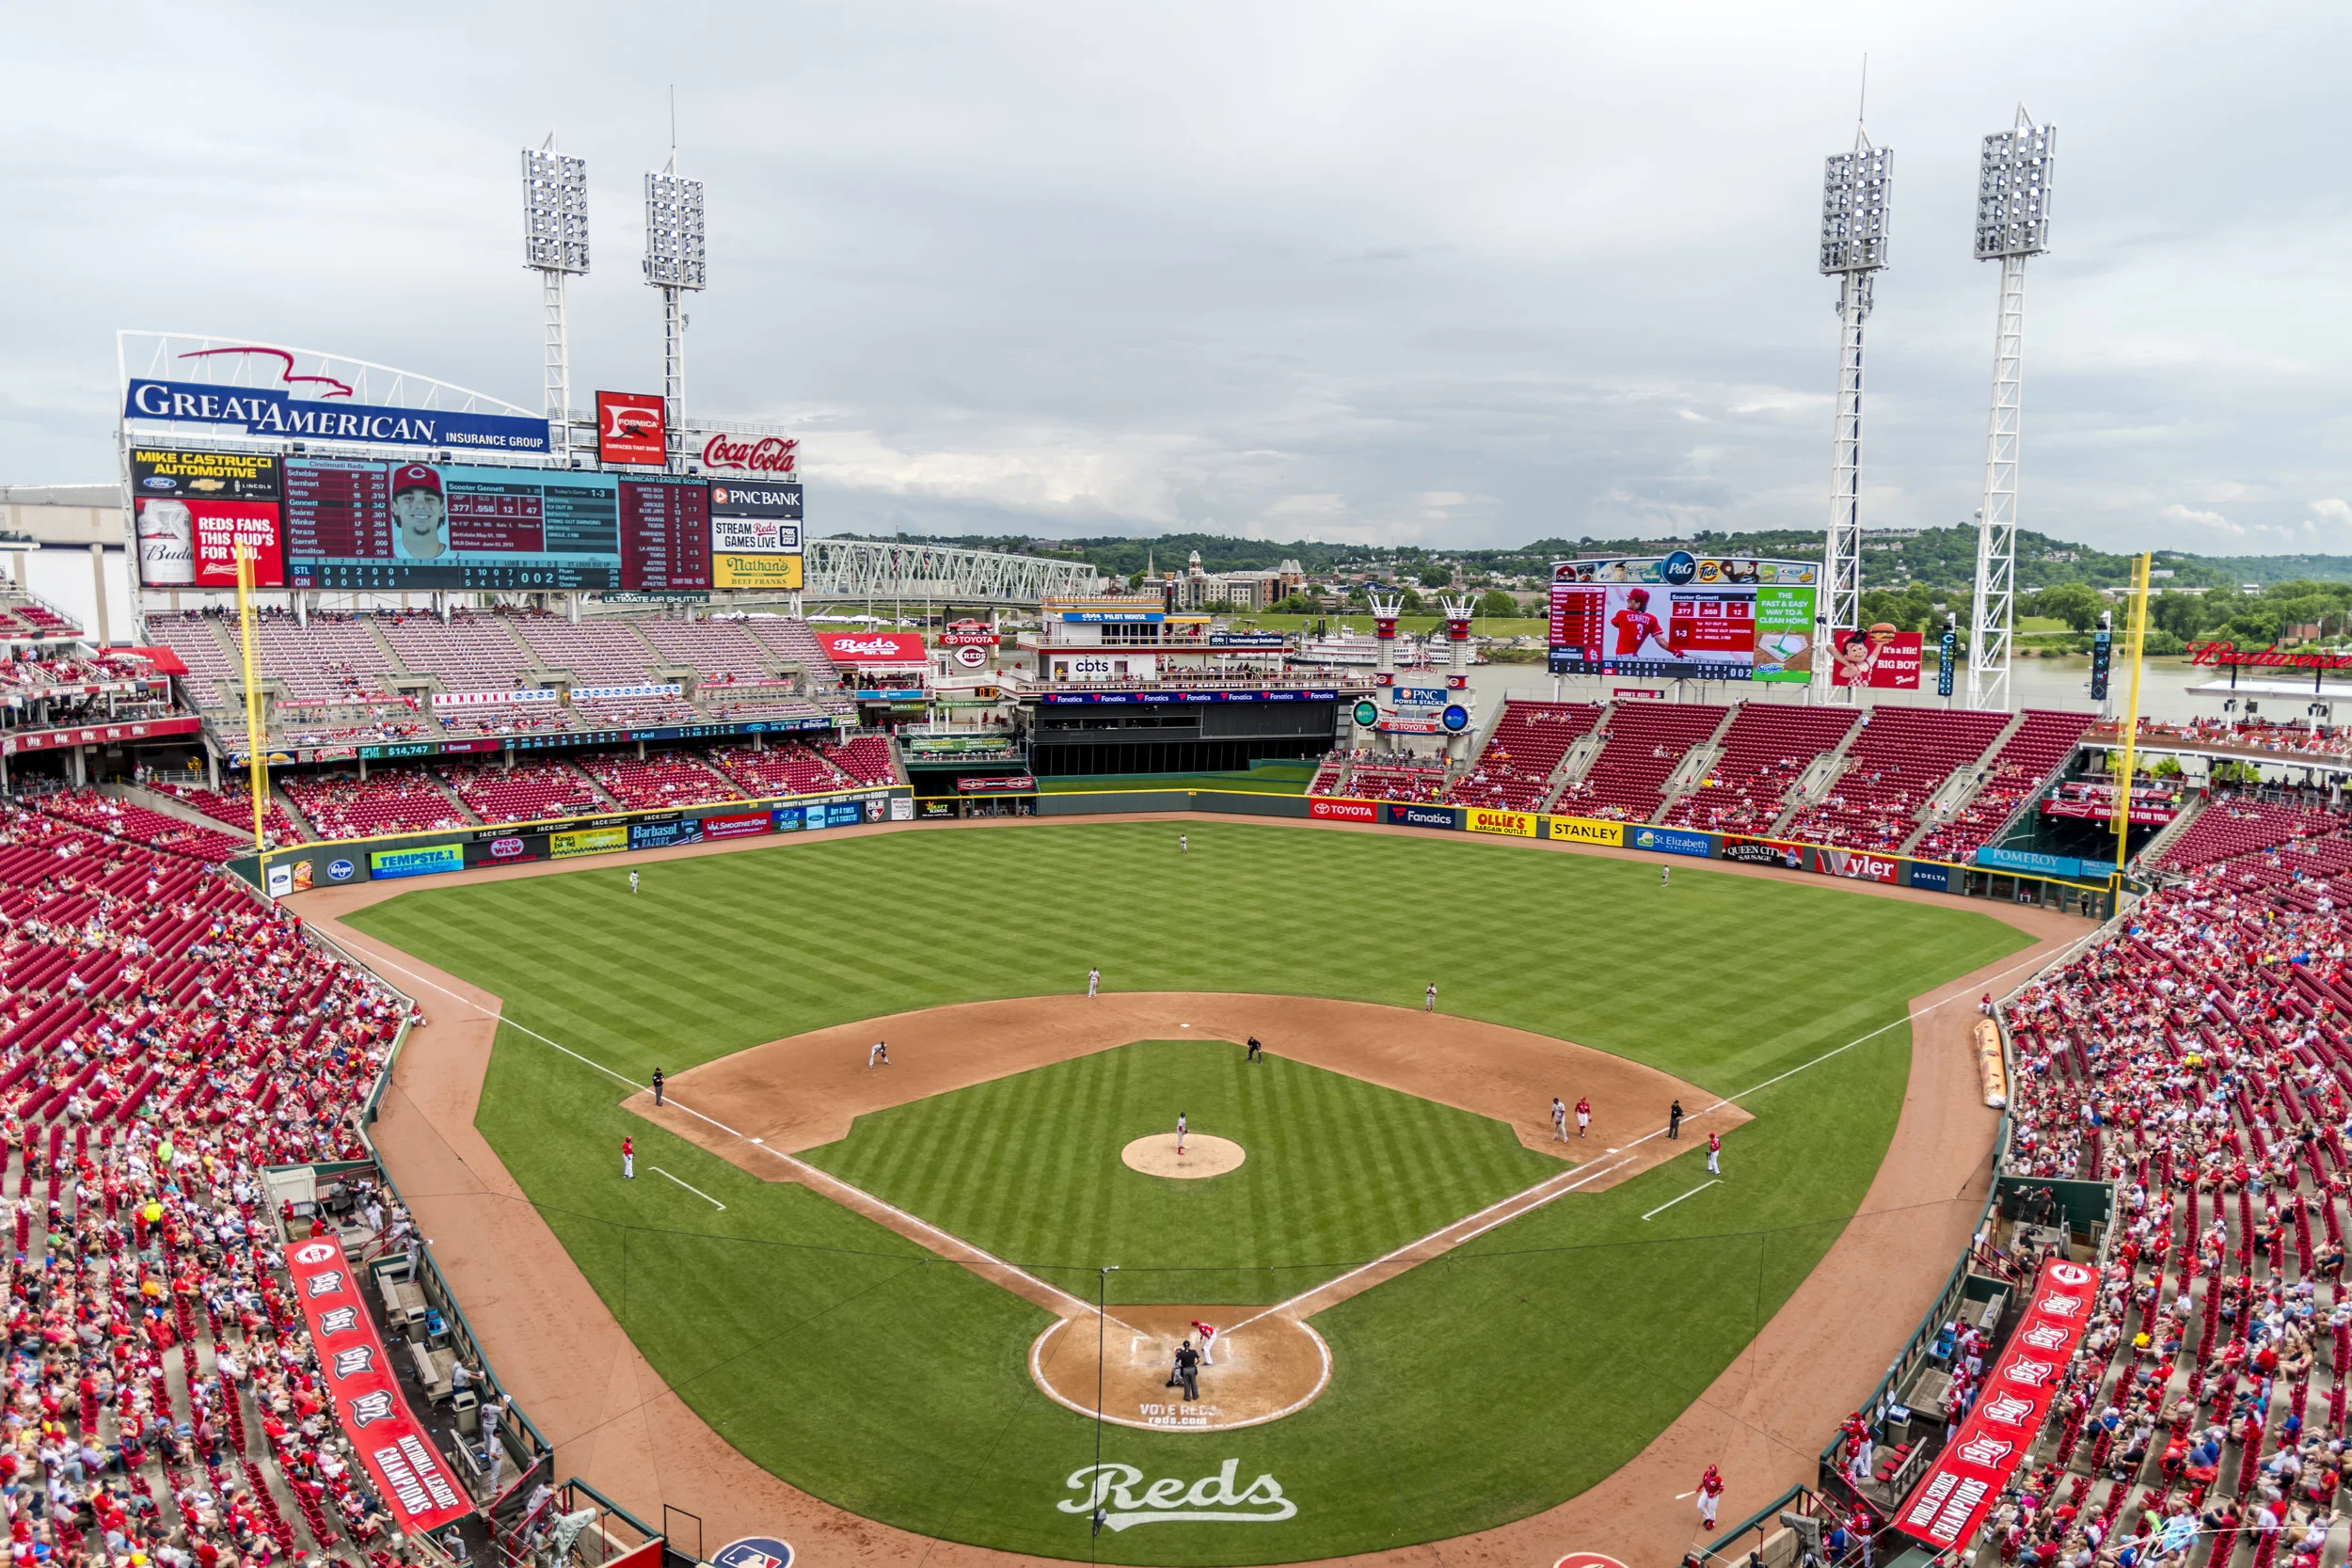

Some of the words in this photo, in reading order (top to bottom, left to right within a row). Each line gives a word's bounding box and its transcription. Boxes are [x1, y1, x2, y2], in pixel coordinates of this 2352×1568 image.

[135, 384, 274, 421] GREAT
[618, 419, 659, 428] FORMICA
[445, 432, 505, 448] INSURANCE
[509, 436, 544, 449] GROUP
[135, 451, 177, 463] MIKE
[182, 453, 272, 467] CASTRUCCI
[703, 434, 800, 472] Coca-Cola
[153, 464, 257, 478] AUTOMOTIVE
[199, 517, 234, 531] REDS
[237, 519, 274, 533] FANS,
[716, 523, 752, 534] STREAM
[753, 522, 778, 536] Reds
[199, 532, 231, 545] THIS
[233, 533, 275, 546] BUD'S
[725, 536, 755, 547] GAMES
[757, 537, 776, 547] LIVE
[201, 546, 228, 560] FOR
[726, 557, 790, 573] Nathan's
[1668, 562, 1692, 575] P&G
[1700, 567, 1719, 578] Tide
[833, 637, 900, 653] Reds
[2186, 641, 2352, 669] Budweise
[1075, 659, 1108, 672] cbts
[1756, 664, 1784, 673] Swiffer
[1877, 660, 1895, 669] BIG
[1897, 661, 1917, 670] BOY
[1413, 689, 1438, 700] PNC
[389, 745, 429, 755] $14,747
[870, 791, 889, 800] 69050
[1331, 805, 1373, 816] TOYOTA
[2052, 802, 2089, 813] Budweiser
[2094, 807, 2110, 816] THIS
[2153, 813, 2170, 822] YOU.
[1407, 811, 1452, 824] Fanatics
[633, 823, 677, 839] Barbasol
[719, 820, 752, 830] SMOOTHIE
[1503, 827, 1528, 835] OUTLET
[1554, 823, 1618, 840] STANLEY
[642, 836, 670, 847] RAZORS
[1666, 836, 1708, 849] Elizabeth
[495, 846, 521, 854] WLW
[1727, 846, 1758, 856] QUEEN
[380, 849, 454, 866] TEMPSTAR
[1738, 854, 1772, 863] SAUSAGE
[1816, 847, 1895, 877] Wyler
[1993, 849, 2058, 866] POMEROY
[330, 866, 353, 876] Kroger
[1921, 872, 1947, 881] DELTA
[325, 1308, 354, 1331] 1961
[2028, 1326, 2065, 1348] 1976
[340, 1347, 365, 1373] 1970
[2010, 1361, 2048, 1384] 1975
[357, 1392, 385, 1421] 1972
[1139, 1403, 1176, 1416] VOTE
[1988, 1396, 2029, 1422] 1940
[1148, 1416, 1207, 1425] reds.com
[1964, 1438, 2008, 1466] 1919
[397, 1433, 436, 1478] NATIONAL
[424, 1473, 460, 1510] LEAGUE
[374, 1446, 433, 1516] CHAMPIONS
[1057, 1458, 1298, 1532] Reds
[1907, 1494, 1941, 1528] WORLD
[1926, 1470, 1960, 1503] SERIES
[1930, 1477, 1989, 1542] CHAMPIONS
